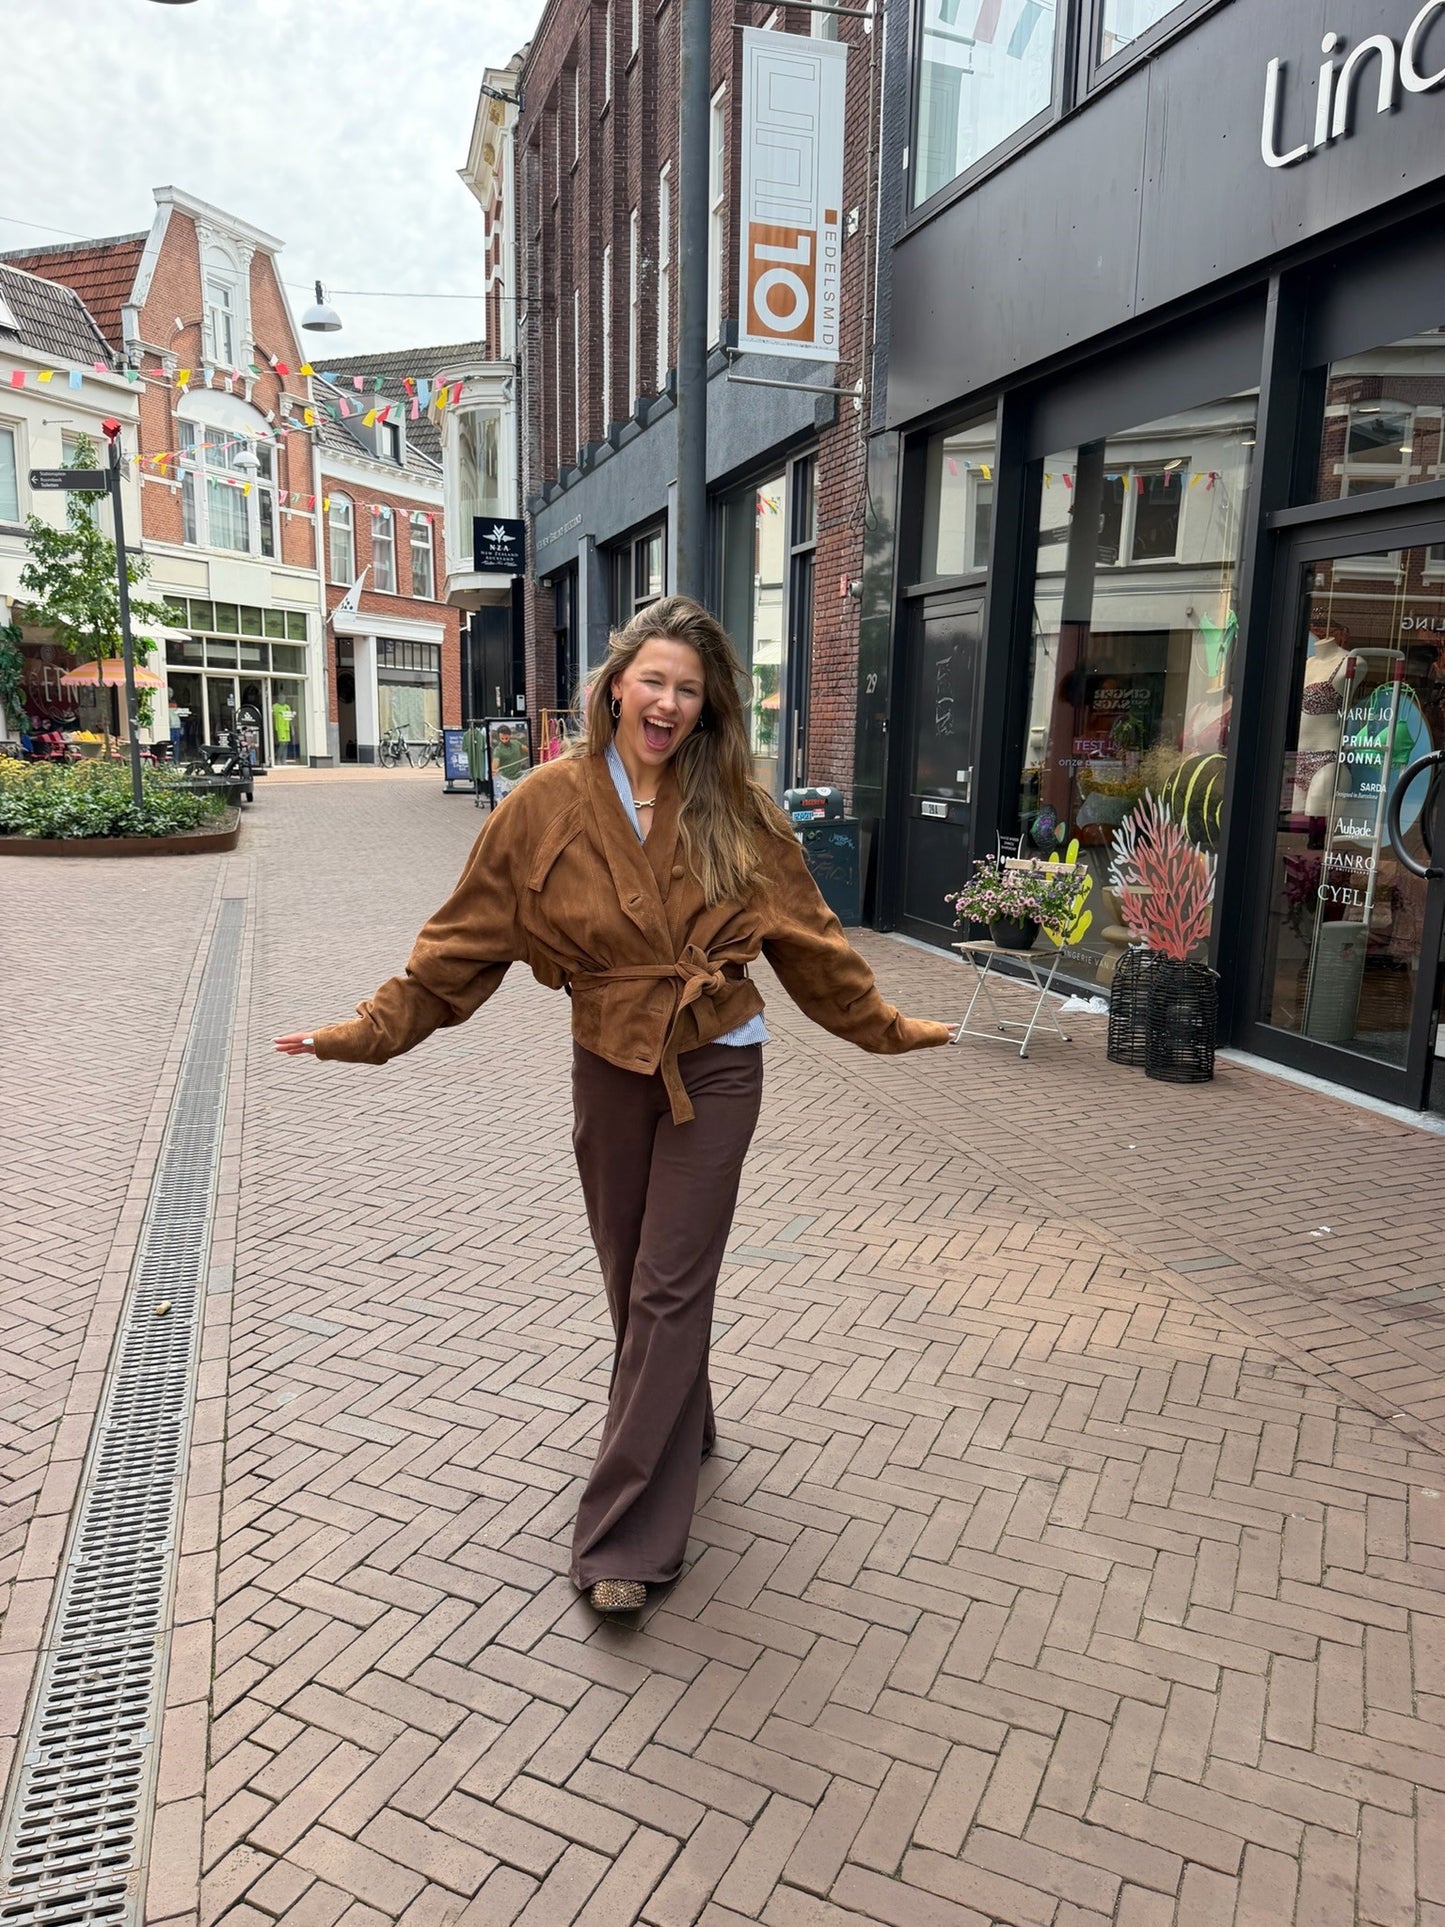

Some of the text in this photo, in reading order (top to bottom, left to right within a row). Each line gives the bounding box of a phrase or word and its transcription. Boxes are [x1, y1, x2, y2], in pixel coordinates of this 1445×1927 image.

[753, 235, 811, 332] 10
[822, 230, 837, 346] EDELSMID
[866, 673, 877, 693] 29
[1336, 707, 1394, 722] MARIE JO
[1074, 740, 1105, 751] TEST
[1342, 735, 1382, 748] PRIMA
[1339, 752, 1382, 765] DONNA
[1360, 782, 1387, 793] SARDA
[1333, 817, 1372, 837] Aubade
[1324, 851, 1376, 870] HANRO
[1317, 884, 1375, 909] CYELL
